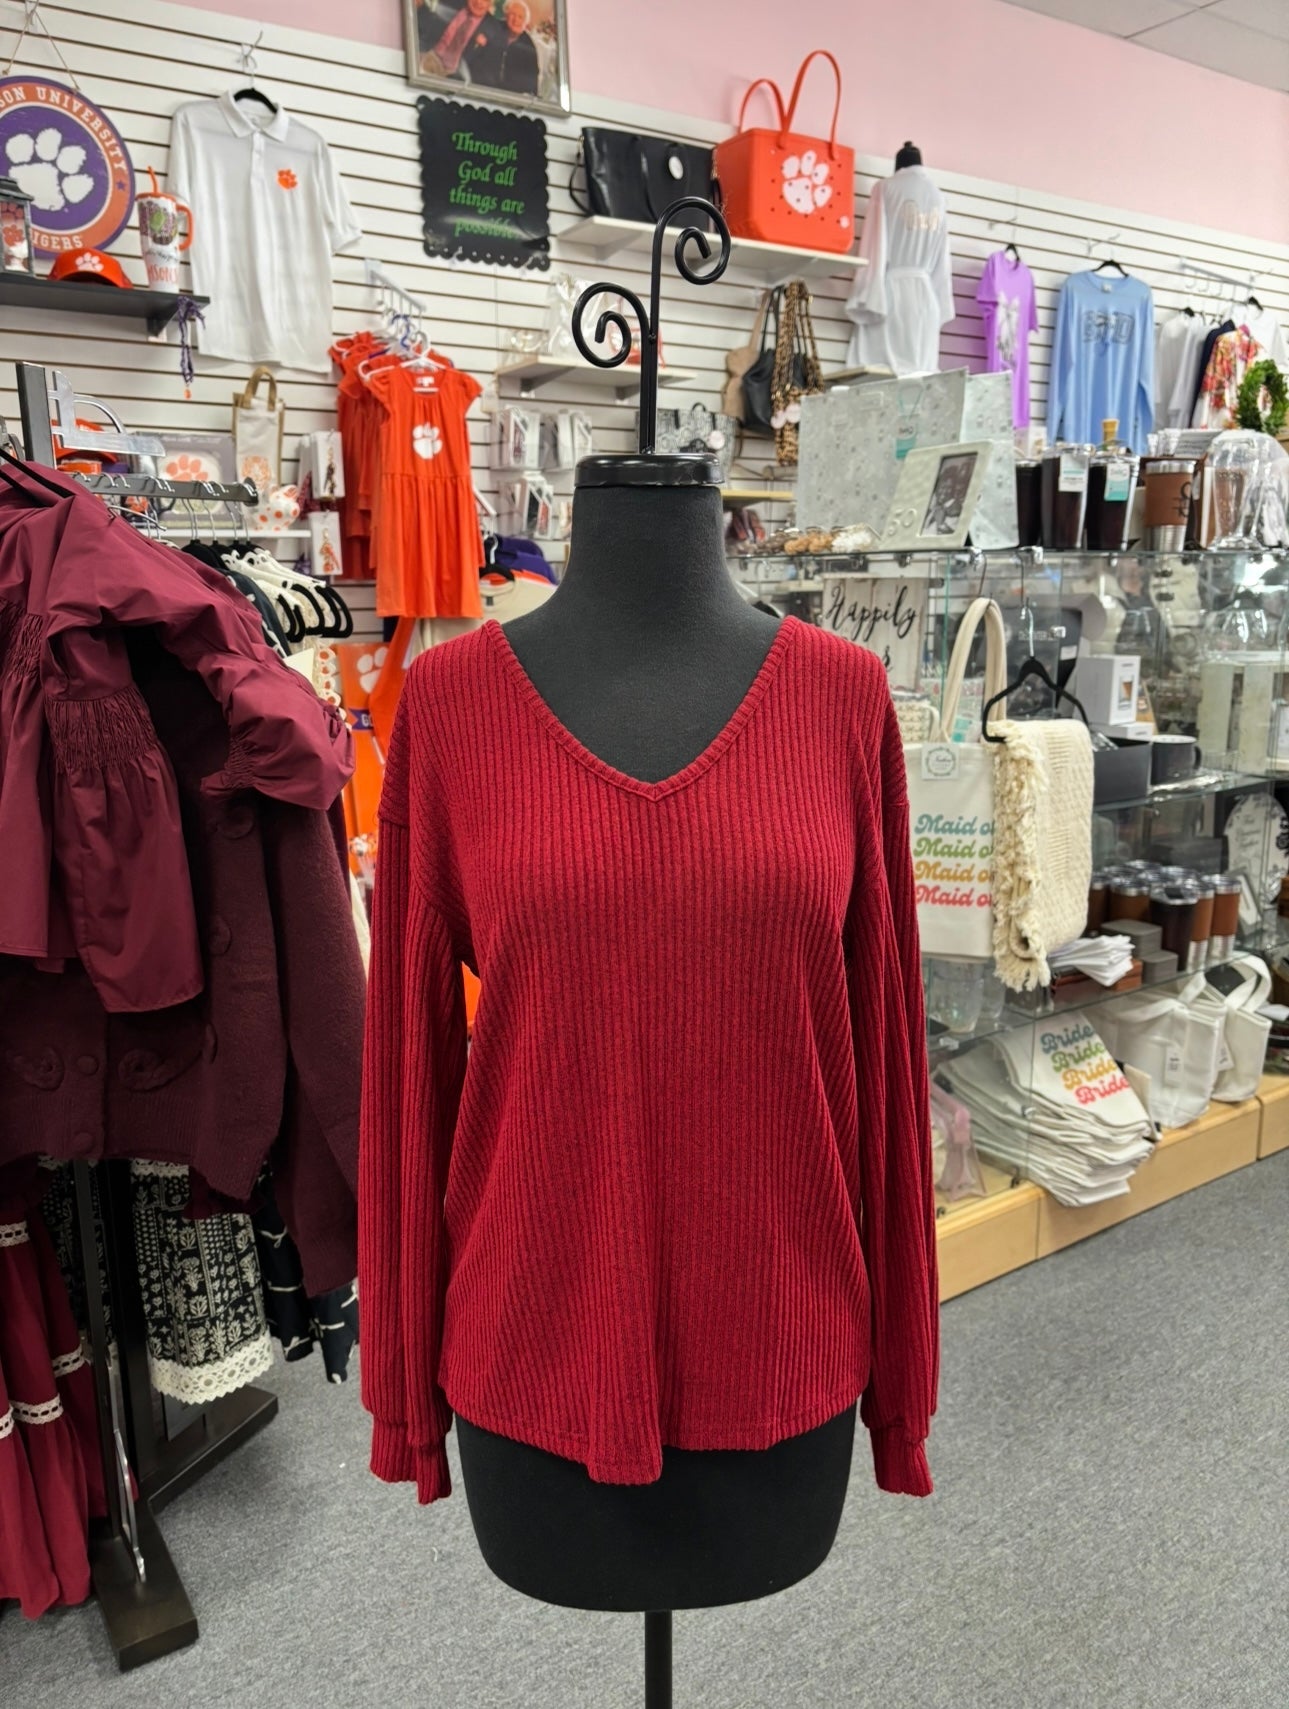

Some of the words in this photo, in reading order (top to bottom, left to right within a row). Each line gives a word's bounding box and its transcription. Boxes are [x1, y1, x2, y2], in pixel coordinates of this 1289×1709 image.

[35, 86, 128, 172] UNIVERSITY
[452, 131, 518, 165] Through
[458, 160, 494, 184] God
[494, 166, 518, 187] all
[449, 184, 498, 214] things
[501, 199, 525, 214] are
[825, 585, 916, 642] Happily
[914, 813, 978, 836] Maid
[913, 837, 976, 858] Maid
[914, 860, 976, 882] Maid
[915, 884, 974, 907] Maid
[1041, 1024, 1096, 1054] Bride
[1051, 1040, 1106, 1073] Bride
[1062, 1057, 1118, 1091] Bride
[1075, 1074, 1131, 1106] Bride
